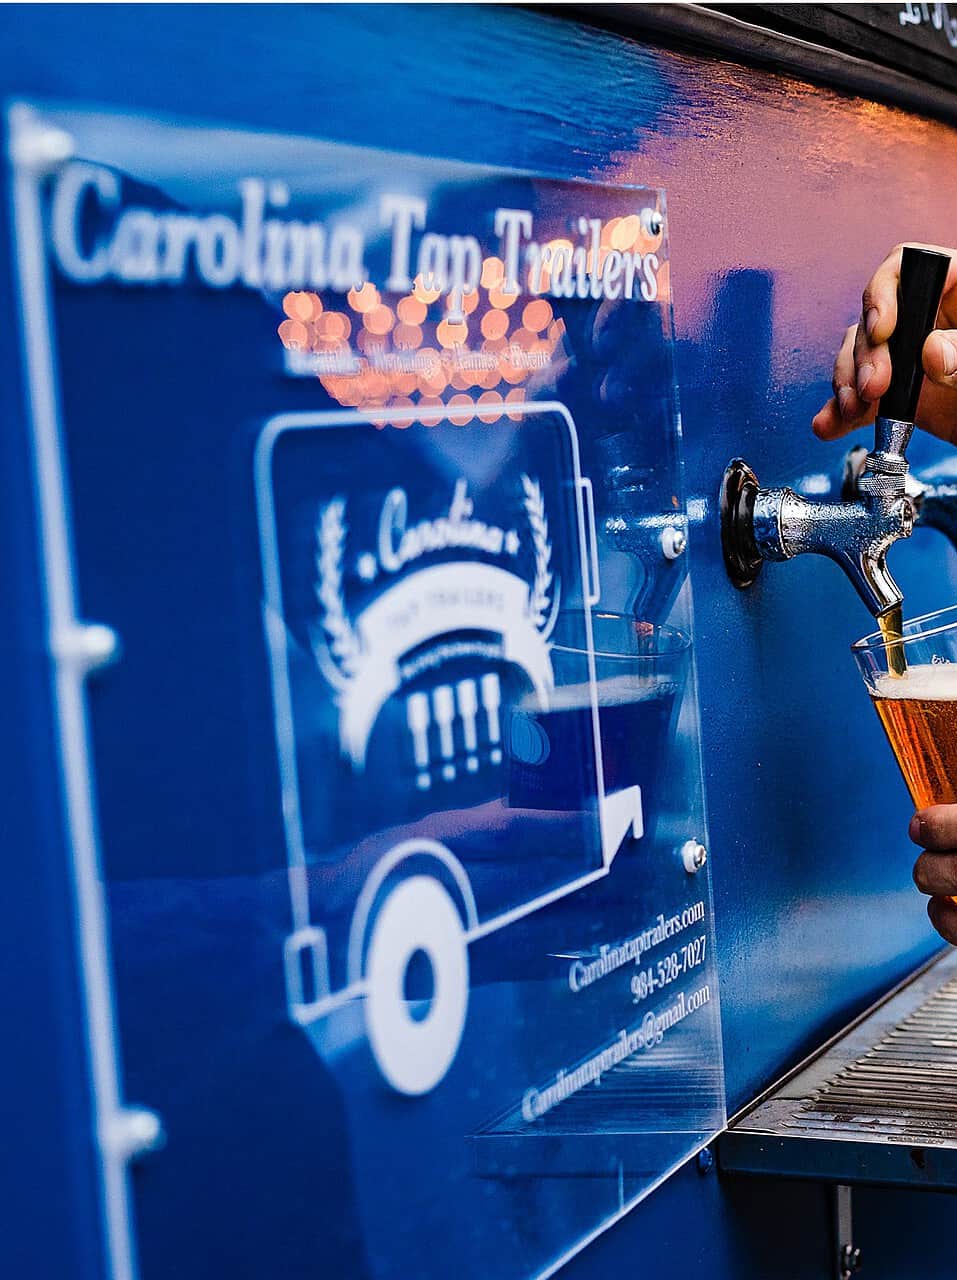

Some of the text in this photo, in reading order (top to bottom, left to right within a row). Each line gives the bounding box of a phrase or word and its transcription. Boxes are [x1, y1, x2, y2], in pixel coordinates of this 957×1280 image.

[52, 160, 660, 326] Carolina Tap Trailers
[630, 934, 706, 1004] 984-528-7027
